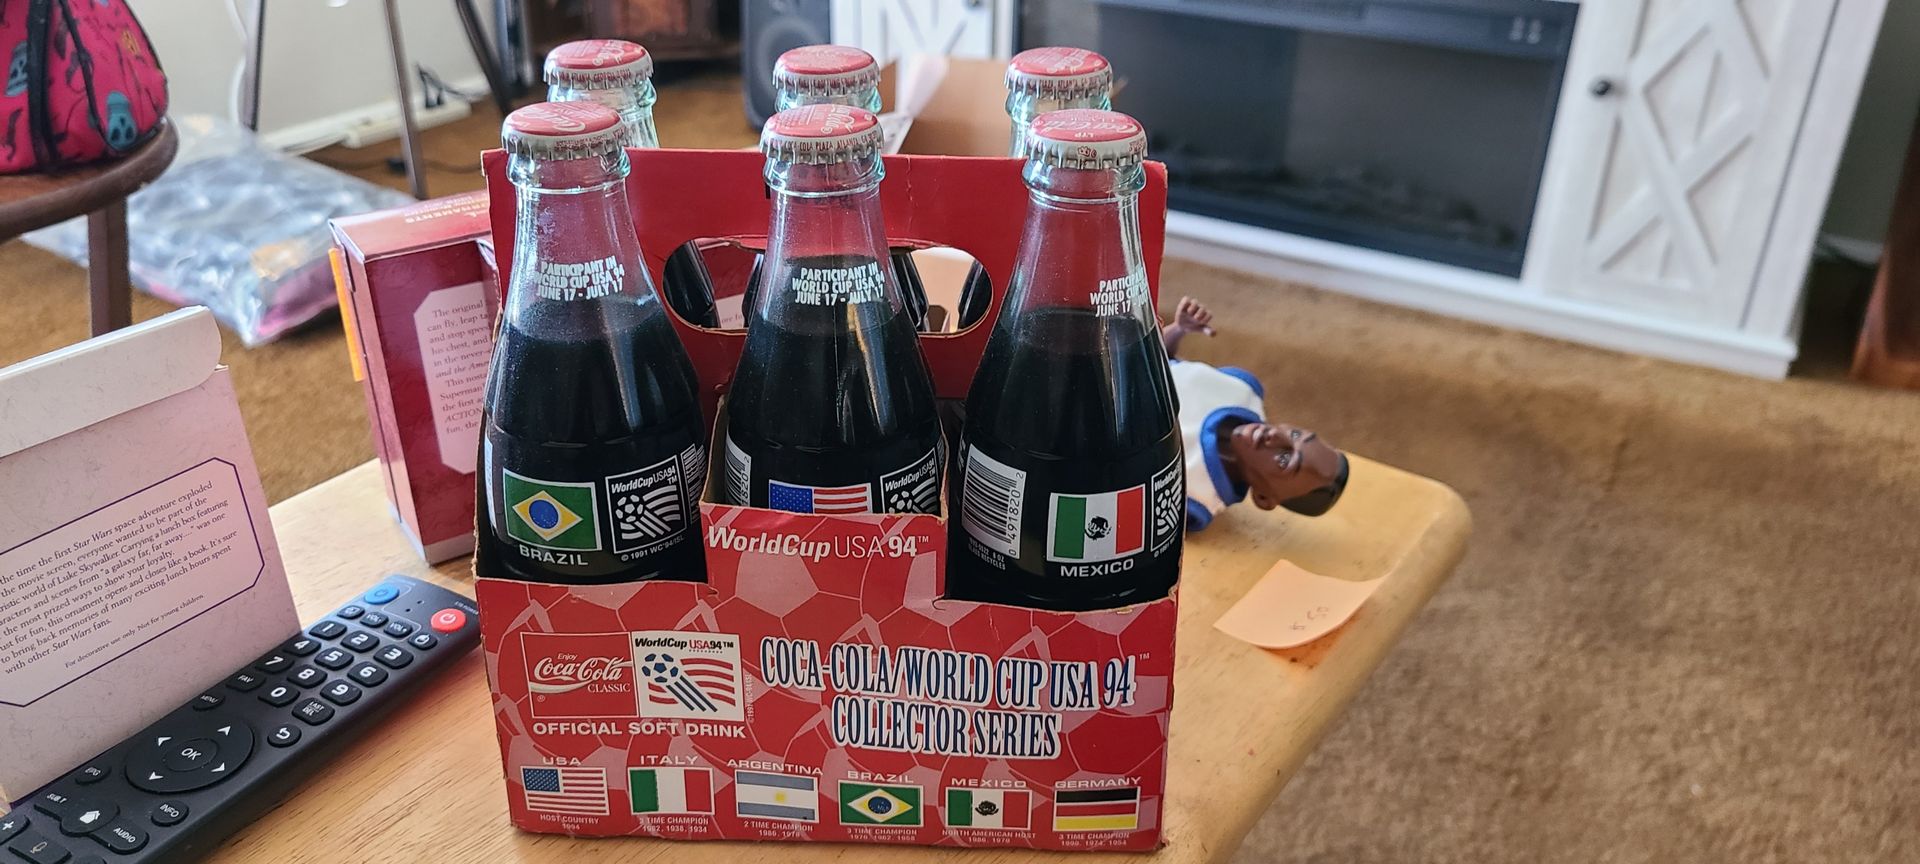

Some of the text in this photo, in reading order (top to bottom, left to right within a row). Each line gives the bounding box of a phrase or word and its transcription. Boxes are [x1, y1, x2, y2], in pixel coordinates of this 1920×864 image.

[541, 255, 617, 277] PARTICIPANT IN
[800, 261, 879, 282] PARTICIPANT IN
[534, 271, 568, 289] WORLD
[569, 275, 590, 289] CUP
[591, 270, 613, 285] USA
[792, 276, 875, 294] WORLD CUP USA
[536, 277, 623, 302] JUNE 17 JULY 17
[795, 283, 884, 306] JUNE 17 JULY 17
[1090, 290, 1125, 305] WORLD
[432, 299, 483, 318] The original
[1095, 300, 1131, 317] JUNE 17
[430, 333, 445, 343] and
[473, 335, 488, 346] and
[1006, 489, 1023, 540] 491820
[16, 564, 37, 577] time
[38, 556, 53, 567] the
[54, 547, 72, 560] first
[73, 538, 91, 551] Star
[92, 529, 113, 542] Wars
[114, 518, 136, 532] space
[138, 499, 177, 521] adventure
[178, 480, 213, 503] exploded
[1, 587, 16, 598] the
[18, 573, 45, 590] movie
[77, 541, 114, 562] everyone
[115, 524, 145, 544] wanted
[155, 516, 166, 525] be
[167, 509, 184, 521] part
[185, 501, 194, 512] of
[194, 497, 208, 507] the
[22, 583, 47, 601] world
[47, 577, 56, 589] of
[56, 571, 78, 584] Luke
[120, 535, 155, 553] Carrying
[160, 520, 181, 536] lunch
[181, 514, 197, 526] box
[196, 500, 229, 519] featuring
[708, 525, 885, 563] WorldCup USA
[33, 595, 49, 609] and
[51, 584, 78, 600] scenes
[79, 573, 100, 587] from
[111, 555, 136, 573] galaxy
[151, 543, 163, 552] far
[196, 520, 211, 530] was
[212, 513, 226, 523] one
[519, 543, 589, 566] BRAZIL
[630, 549, 648, 561] 1991
[1060, 558, 1135, 578] MEXICO
[47, 530, 237, 628] this ornament opens closes sure
[11, 545, 232, 658] bring back memories many exciting lunch hours spent
[20, 614, 42, 629] most
[43, 598, 71, 619] prized
[104, 573, 125, 588] show
[127, 563, 145, 578] your
[321, 623, 330, 633] 1
[65, 659, 76, 668] For
[77, 642, 110, 662] decorative
[137, 621, 150, 631] Not
[293, 640, 307, 650] 4
[351, 633, 369, 645] 2
[634, 637, 688, 650] WorldCup
[5, 660, 26, 674] with
[27, 648, 50, 664] other
[52, 638, 70, 652] Star
[70, 627, 92, 641] Wars
[324, 651, 343, 662] 5
[384, 648, 402, 660] 3
[557, 652, 578, 661] Enjoy
[265, 656, 284, 666] 7
[298, 668, 315, 680] 8
[359, 667, 377, 678] 6
[534, 656, 626, 682] Coca-Cola
[760, 636, 993, 705] COCA-COLA/WORLD
[996, 652, 1047, 707] CUP
[1047, 659, 1097, 711] USA
[1099, 652, 1138, 709] 94
[237, 674, 255, 683] FAV
[270, 687, 287, 698] 0
[331, 684, 349, 696] 9
[587, 682, 631, 694] CLASSIC
[200, 694, 219, 704] MENU
[302, 707, 315, 717] DEL
[308, 701, 325, 712] LAST
[532, 721, 747, 739] OFFICIAL SOFT DRINK
[831, 693, 1063, 761] COLLECTOR SERIES
[181, 745, 202, 761] OK
[640, 755, 699, 765] ITALY
[542, 756, 581, 766] USA
[726, 758, 824, 776] ARGENTINA
[847, 770, 915, 784] BRAZIL
[951, 778, 1027, 789] MEXICO
[1055, 776, 1142, 789] GERMANY
[160, 803, 180, 818] INFO
[540, 814, 600, 824] HOST COUNTRY
[647, 816, 709, 825] TIME CHAMPION
[751, 821, 770, 829] TIME
[771, 822, 813, 832] CHAMPION
[854, 827, 917, 836] TIME CHAMPION
[113, 827, 136, 843] AUDIO
[942, 829, 1037, 839] NORTH AMERICAN HOST
[1087, 832, 1130, 840] CHAMPION
